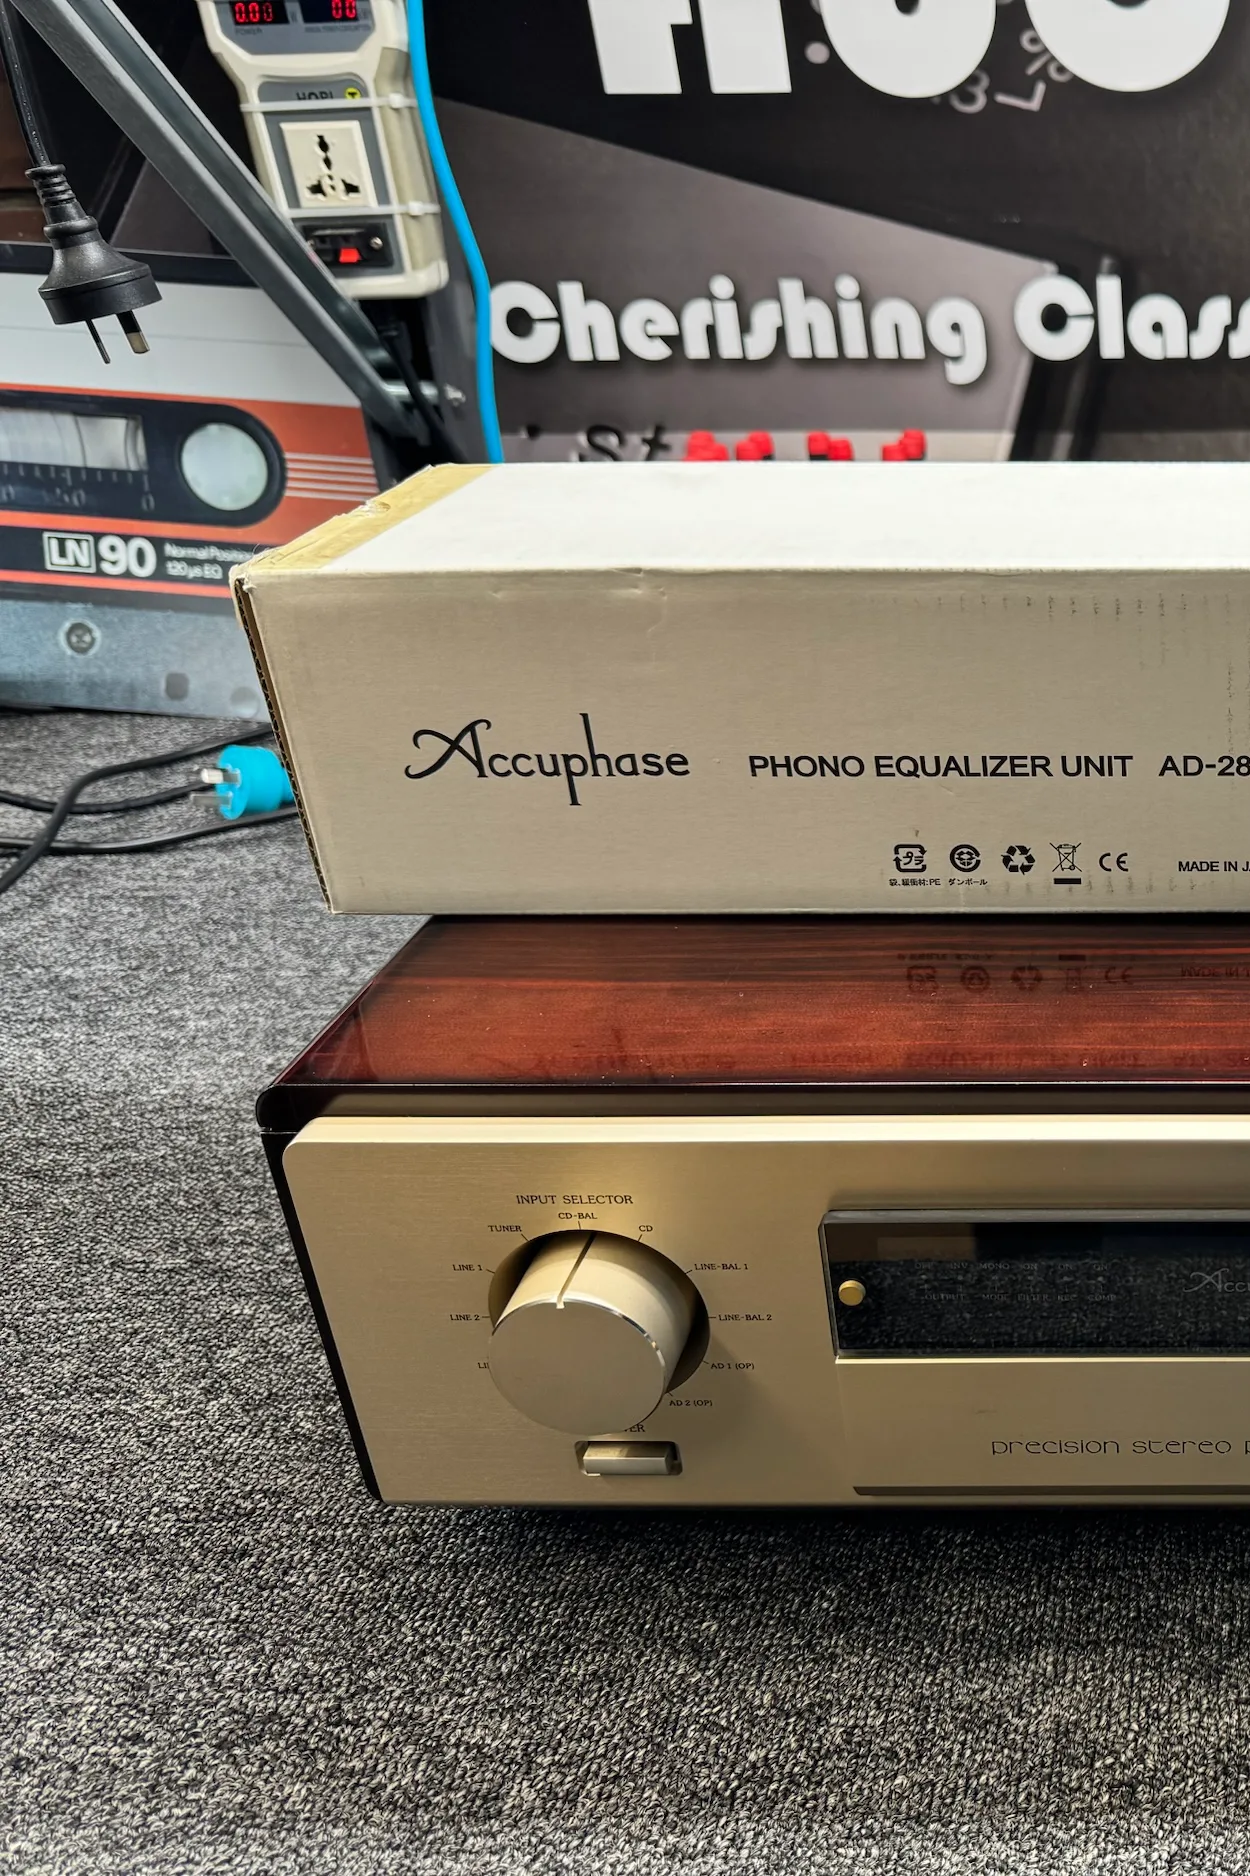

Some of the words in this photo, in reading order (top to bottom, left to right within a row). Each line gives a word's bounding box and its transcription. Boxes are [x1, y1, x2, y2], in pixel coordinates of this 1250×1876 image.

[490, 274, 988, 385] Cherishing
[98, 534, 157, 578] 90
[404, 712, 691, 806] Accuphase
[749, 754, 865, 777] PHONO
[874, 754, 1054, 780] EQUALIZER
[1061, 754, 1134, 777] UNIT
[1178, 860, 1220, 873] MADE
[1223, 860, 1238, 873] IN
[516, 1195, 557, 1205] INPUT
[563, 1194, 633, 1205] SELECTOR
[558, 1212, 598, 1220] CD-BAL
[488, 1225, 522, 1233] TUNER
[639, 1224, 653, 1232] CD
[694, 1263, 741, 1271] LINE-BAL
[711, 1362, 725, 1370] AD
[735, 1361, 755, 1371] (OP)
[669, 1399, 683, 1407] AD
[693, 1399, 713, 1407] (OP)
